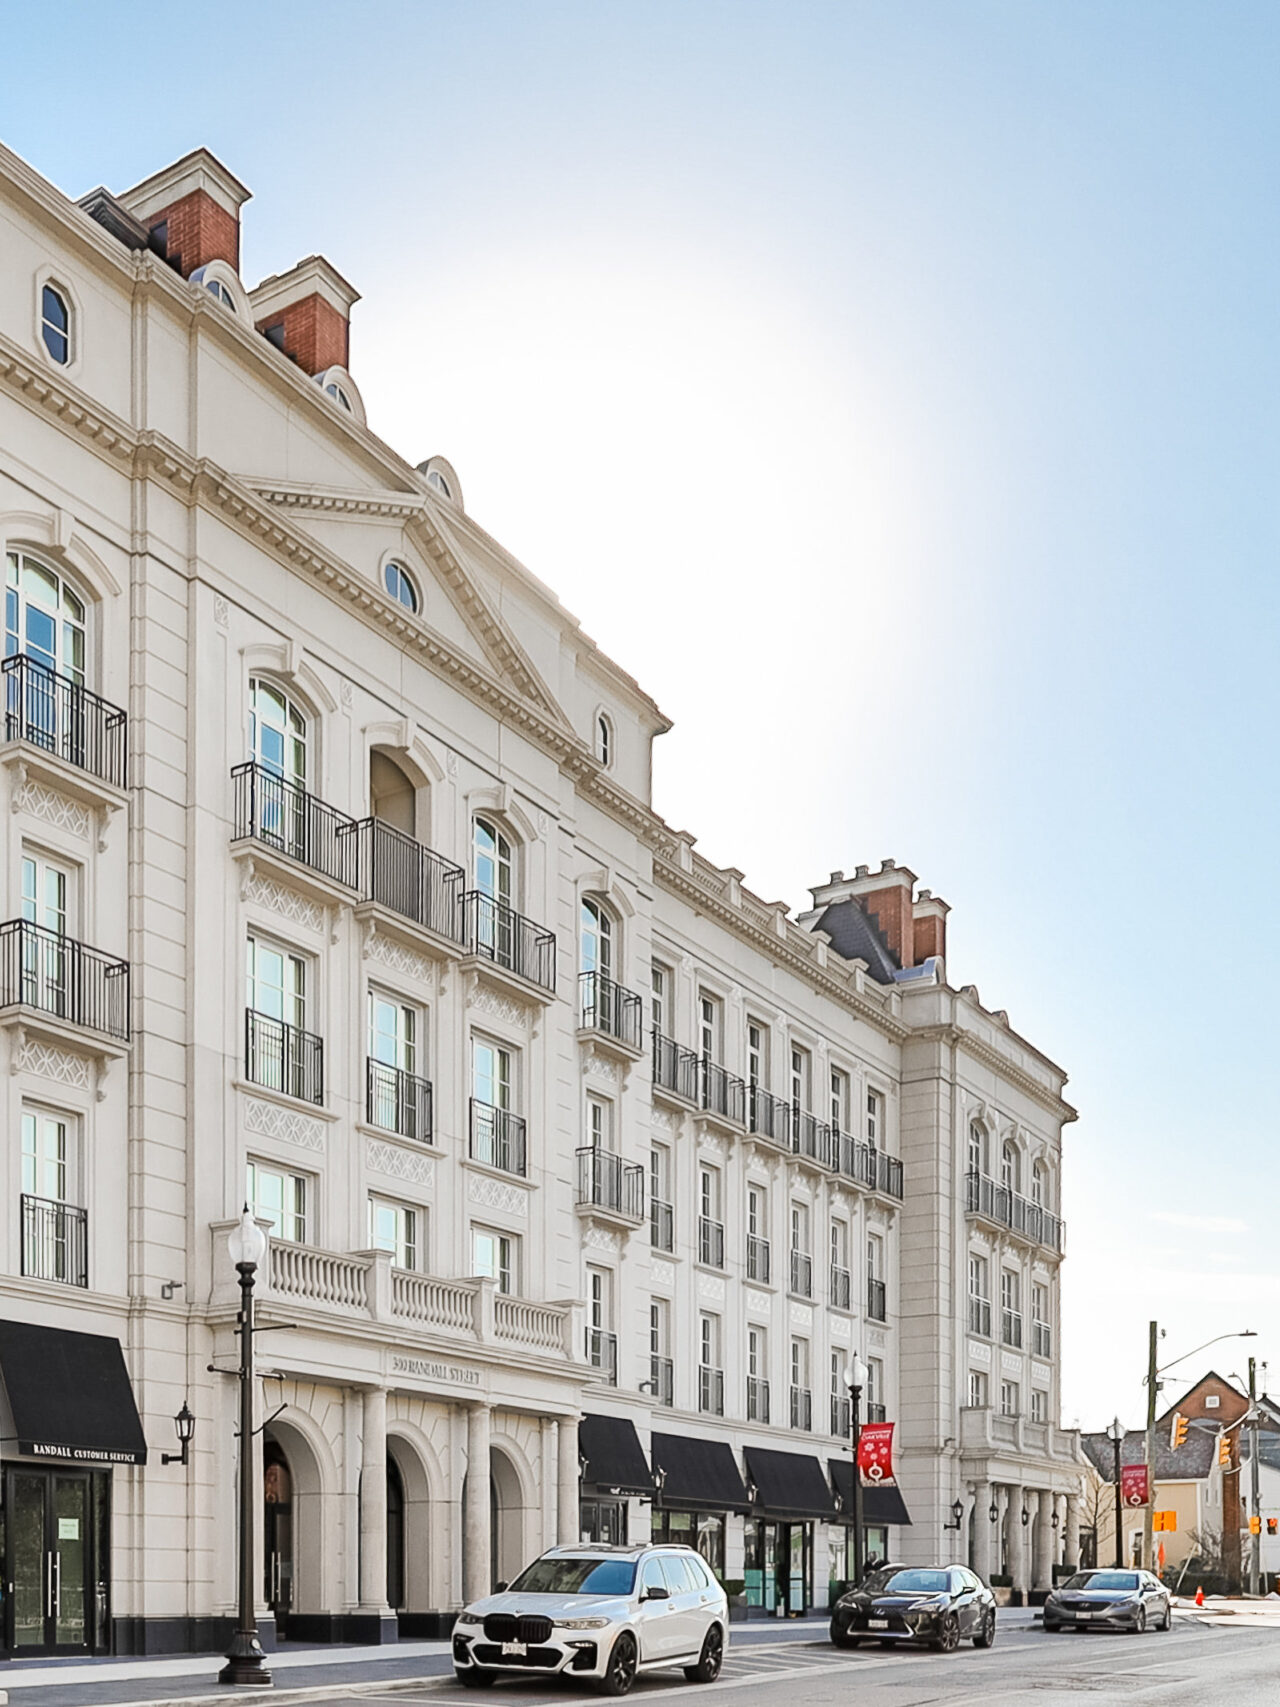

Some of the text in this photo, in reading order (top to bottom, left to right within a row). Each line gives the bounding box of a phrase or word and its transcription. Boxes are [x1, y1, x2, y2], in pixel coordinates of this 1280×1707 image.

[408, 1360, 447, 1379] RANDALL
[450, 1367, 480, 1385] STREET
[33, 1444, 135, 1462] RANDALL CUSTOMER SERVICE
